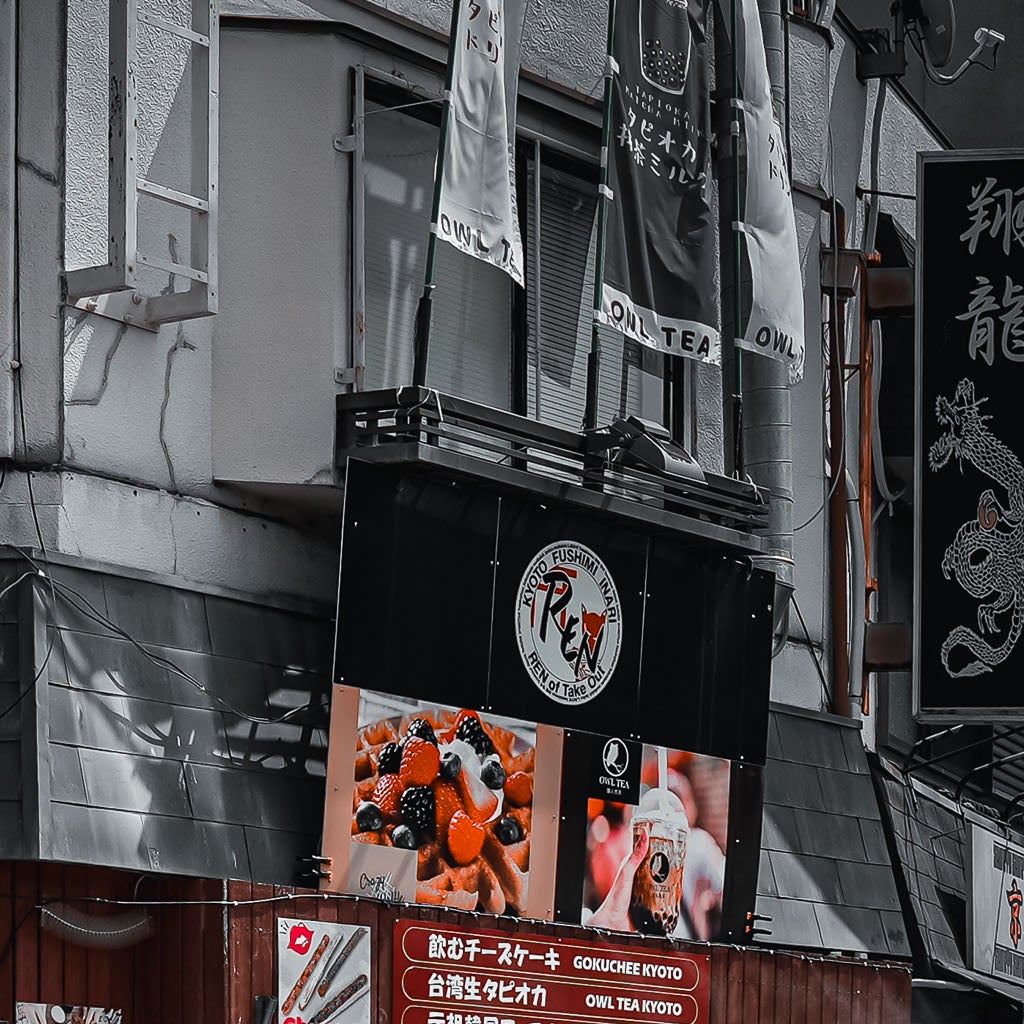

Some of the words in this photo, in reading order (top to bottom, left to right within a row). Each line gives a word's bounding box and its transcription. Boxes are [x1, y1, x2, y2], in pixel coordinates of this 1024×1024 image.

[628, 107, 697, 163] タピオカ
[441, 212, 490, 254] OWL
[661, 326, 710, 358] TEA
[755, 326, 795, 359] OWL
[522, 560, 548, 608] KYOTO
[552, 549, 599, 577] FUSHIMI
[599, 578, 617, 624] INARI
[528, 650, 549, 683] REN
[548, 680, 560, 694] of
[562, 683, 586, 698] Take
[588, 664, 606, 688] Out
[616, 778, 630, 790] TEA
[428, 934, 560, 971] 飲むチーズケーキ
[573, 955, 641, 976] GOKUCHEE
[642, 964, 683, 981] KYOTO
[427, 972, 547, 1007] 台湾生タピオカ
[585, 993, 614, 1010] OWL
[617, 996, 640, 1012] TEA
[642, 999, 683, 1016] KYOTO
